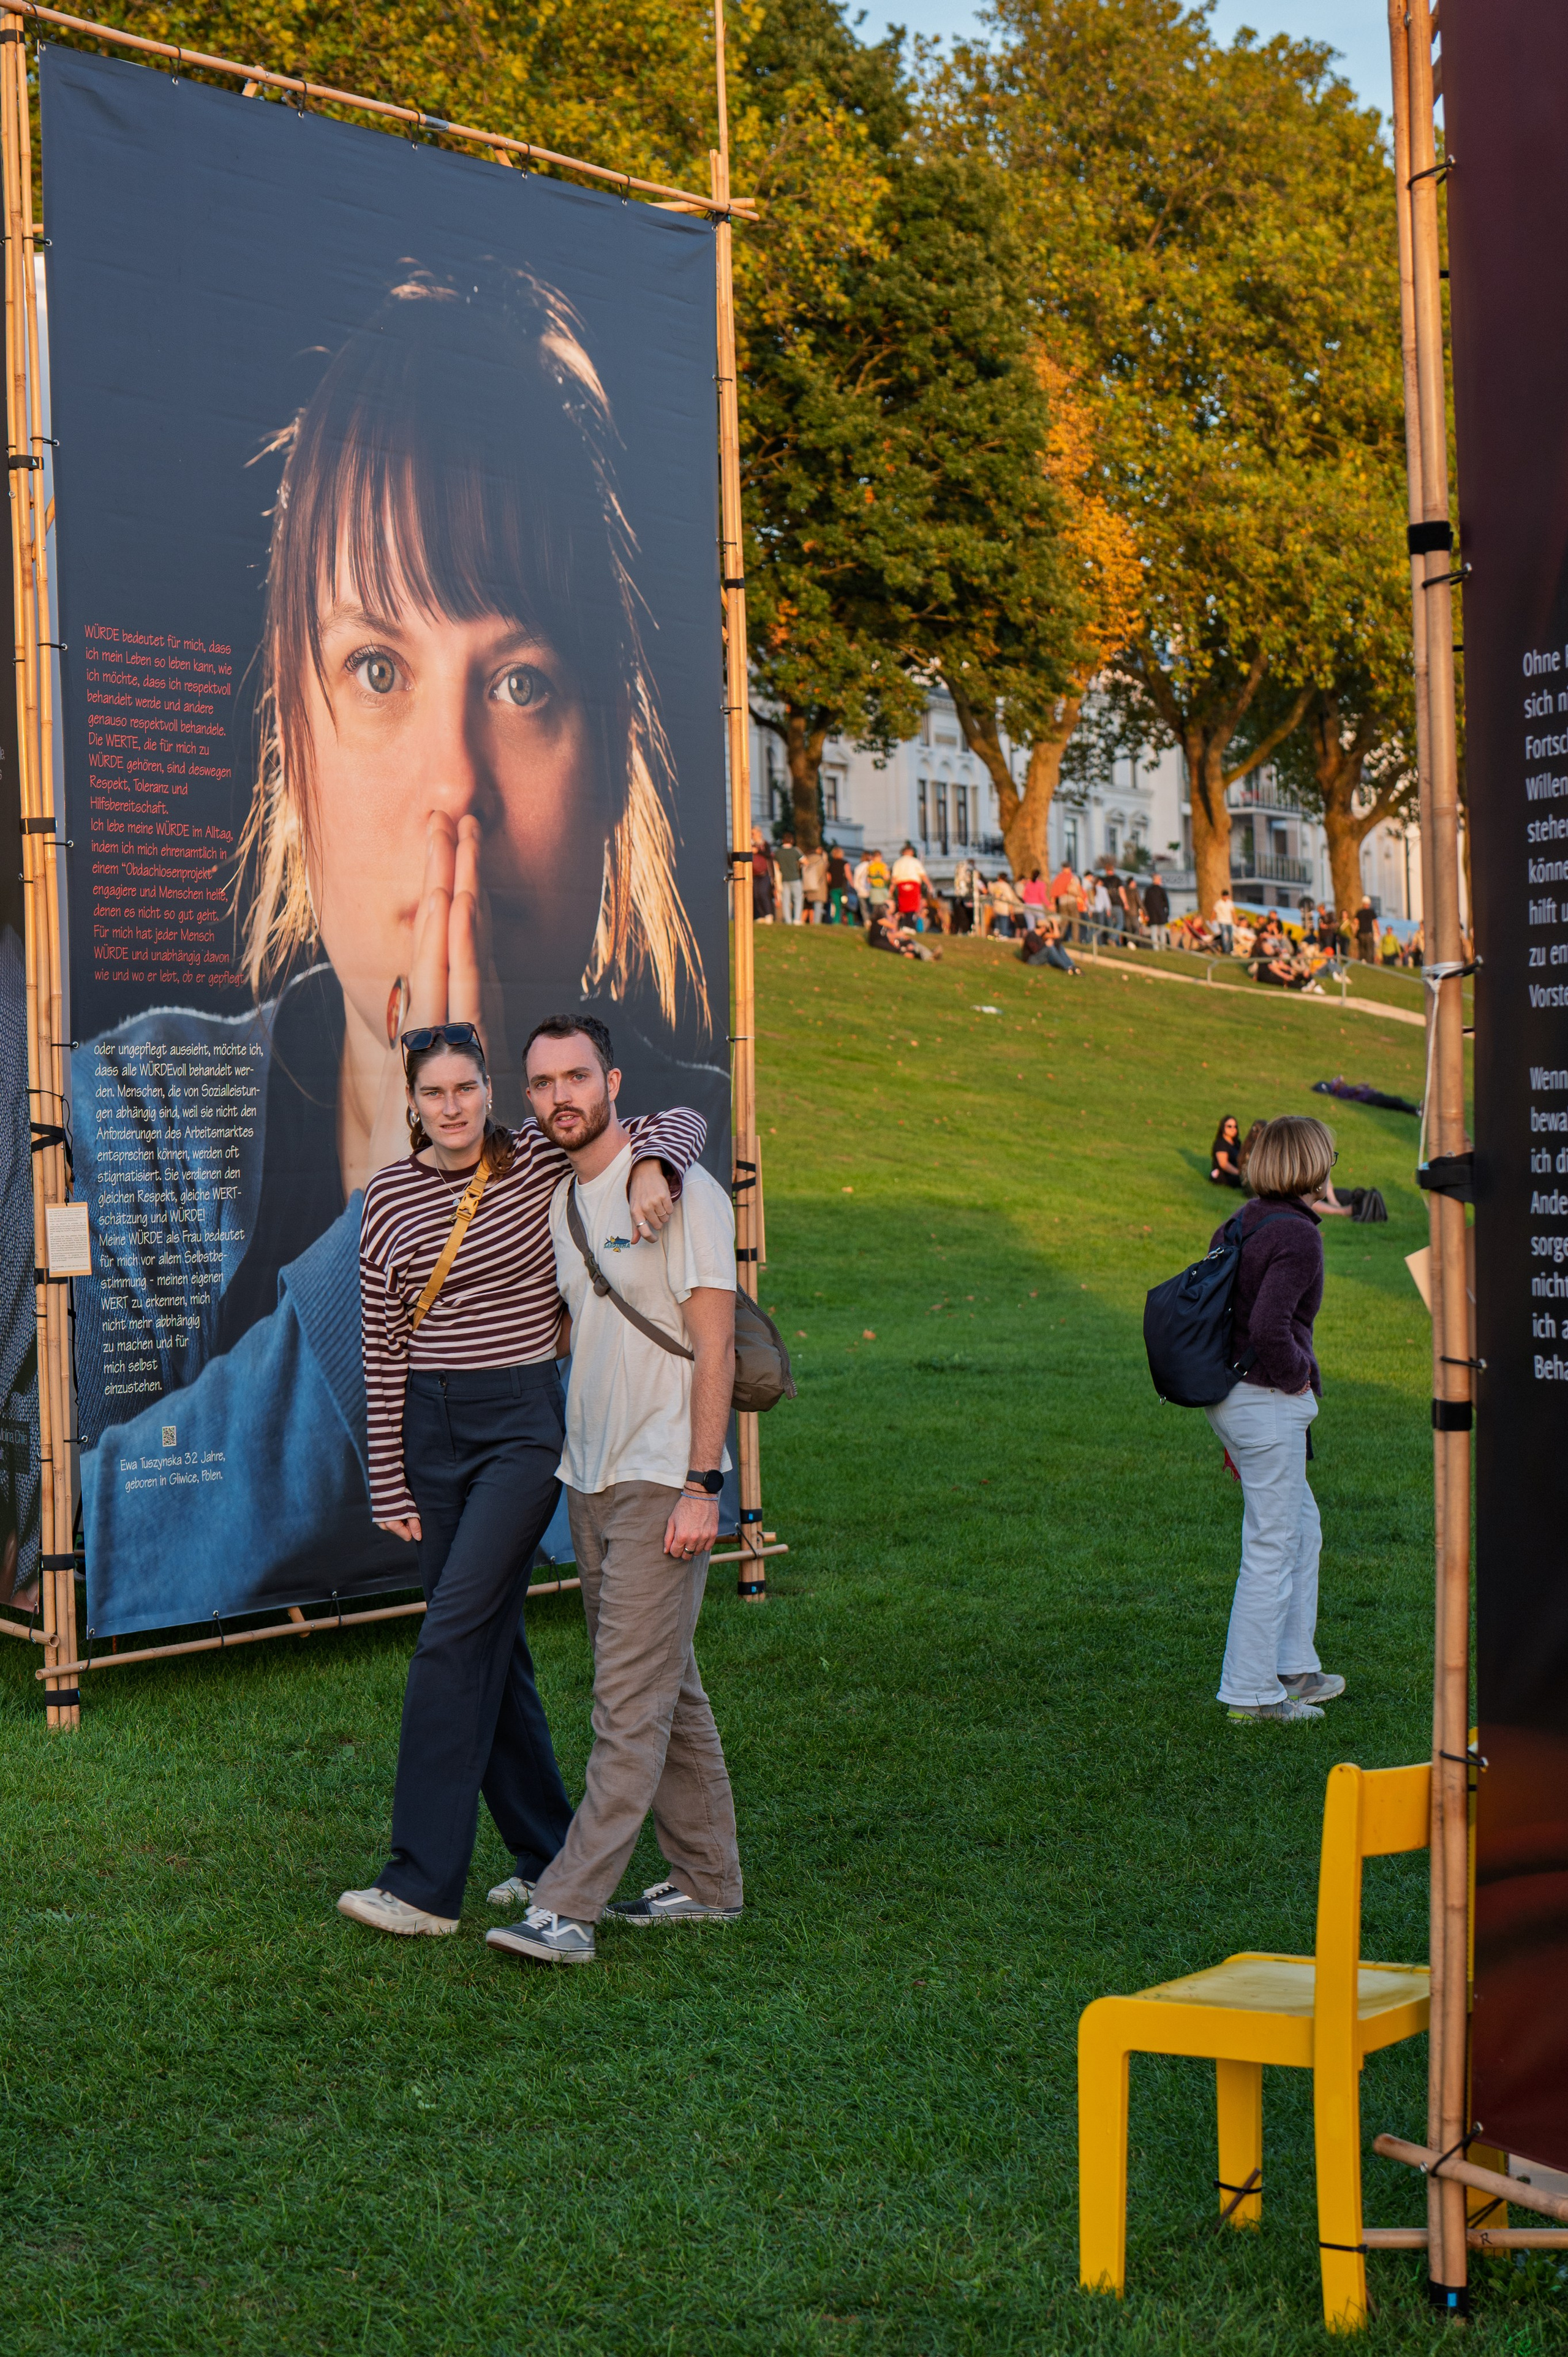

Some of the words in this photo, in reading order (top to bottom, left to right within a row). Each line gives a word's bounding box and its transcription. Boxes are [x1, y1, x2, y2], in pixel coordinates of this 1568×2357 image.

[85, 623, 119, 641] WÜRDE
[123, 629, 164, 647] bedeutet
[167, 635, 180, 648] für
[184, 638, 206, 653] mich,
[209, 641, 232, 654] dass
[1523, 649, 1561, 678] Ohne
[86, 668, 99, 681] ich
[103, 672, 140, 686] möchte,
[143, 675, 165, 689] dass
[169, 678, 181, 690] ich
[184, 681, 231, 697] respektvoll
[87, 689, 132, 706] behandelt
[135, 697, 160, 709] werde
[164, 699, 180, 711] und
[184, 701, 213, 714] andere
[1524, 688, 1553, 719] sich
[88, 714, 127, 727] genauso
[130, 717, 178, 733] respektvoll
[181, 719, 226, 736] behandele.
[89, 732, 103, 745] Die
[105, 734, 141, 751] WERTE,
[144, 738, 157, 751] die
[159, 739, 173, 752] für
[176, 741, 196, 754] mich
[200, 746, 209, 755] zu
[1525, 732, 1568, 760] Fortsc
[89, 752, 123, 768] WÜRDE
[127, 757, 164, 773] gehören,
[167, 761, 185, 773] sind
[189, 763, 232, 780] deswegen
[90, 775, 130, 793] Respekt,
[134, 779, 168, 794] Toleranz
[172, 783, 187, 795] und
[91, 796, 168, 814] Hilfsbereitschaft.
[91, 818, 104, 831] Ich
[107, 819, 124, 832] lebe
[128, 824, 153, 834] meine
[156, 821, 189, 836] WÜRDE
[192, 825, 202, 837] im
[205, 826, 233, 842] Alltag,
[91, 840, 118, 853] indem
[122, 842, 134, 854] ich
[138, 843, 157, 855] mich
[161, 844, 217, 858] ehrenamtlich
[220, 849, 227, 859] in
[92, 863, 118, 874] einem
[1529, 858, 1568, 885] könne
[93, 885, 137, 899] engagiere
[140, 883, 156, 897] und
[159, 886, 203, 901] Menschen
[206, 888, 228, 902] helfe,
[94, 904, 121, 917] denen
[124, 908, 135, 917] es
[138, 906, 161, 918] nicht
[164, 910, 175, 920] so
[178, 908, 194, 923] gut
[197, 909, 219, 923] geht.
[1529, 897, 1558, 926] hilft
[94, 925, 108, 937] Für
[113, 926, 133, 939] mich
[136, 927, 152, 939] hat
[154, 928, 177, 943] jeder
[181, 929, 214, 941] Mensch
[94, 944, 128, 960] WÜRDE
[132, 947, 148, 960] und
[151, 948, 200, 965] unabhängig
[203, 950, 229, 963] davon
[1529, 946, 1545, 967] zu
[1529, 983, 1568, 1008] Vorste
[94, 1042, 115, 1055] oder
[119, 1042, 167, 1059] ungepflegt
[170, 1043, 211, 1056] aussieht,
[214, 1043, 246, 1055] möchte
[249, 1043, 263, 1057] ich,
[94, 1064, 118, 1076] dass
[122, 1064, 137, 1076] alle
[140, 1061, 186, 1076] WÜRDEvoll
[189, 1064, 232, 1076] behandelt
[235, 1066, 254, 1076] wer-
[1530, 1066, 1568, 1091] Wenn
[96, 1084, 114, 1097] den.
[118, 1084, 165, 1099] Menschen,
[168, 1084, 181, 1097] die
[184, 1087, 198, 1097] von
[202, 1084, 260, 1097] Sozialleistun-
[1531, 1105, 1568, 1132] bewa
[96, 1127, 161, 1142] Anforderungen
[165, 1127, 181, 1139] des
[184, 1125, 254, 1138] Arbeitsmarktes
[97, 1148, 154, 1165] entsprechen
[157, 1147, 190, 1160] können,
[192, 1146, 222, 1159] werden
[225, 1146, 239, 1158] oft
[1531, 1147, 1551, 1173] ich
[98, 1170, 162, 1186] stigmatisiert.
[165, 1168, 179, 1180] Sie
[181, 1167, 221, 1180] verdienen
[224, 1167, 240, 1179] den
[98, 1191, 134, 1207] gleichen
[138, 1190, 177, 1206] Respekt,
[180, 1189, 209, 1206] gleiche
[212, 1186, 241, 1200] WERT-
[1531, 1189, 1568, 1216] Ande
[99, 1211, 147, 1227] schätzung
[151, 1209, 167, 1223] und
[170, 1207, 205, 1222] WÜRDE!
[99, 1234, 126, 1246] Meine
[129, 1230, 163, 1245] WÜRDE
[167, 1231, 179, 1244] als
[183, 1230, 202, 1243] Frau
[205, 1228, 245, 1242] bedeutet
[100, 1255, 113, 1268] für
[117, 1254, 138, 1266] mich
[141, 1255, 156, 1266] vor
[159, 1252, 181, 1265] allem
[184, 1250, 227, 1263] Selbstbe-
[100, 1276, 146, 1290] stimmung
[157, 1274, 188, 1286] meinen
[191, 1273, 224, 1287] eigenen
[101, 1296, 129, 1310] WERT
[132, 1298, 142, 1308] zu
[146, 1294, 187, 1307] erkennen,
[190, 1292, 210, 1305] mich
[102, 1318, 126, 1331] nicht
[129, 1316, 153, 1330] mehr
[156, 1314, 200, 1329] abbhängig
[1532, 1312, 1556, 1339] ich
[104, 1342, 114, 1353] zu
[118, 1337, 153, 1351] machen
[156, 1334, 173, 1349] und
[175, 1334, 189, 1347] für
[104, 1358, 125, 1373] mich
[129, 1358, 158, 1372] selbst
[105, 1379, 162, 1395] einzustehen.
[120, 1459, 137, 1470] Ewa
[140, 1455, 182, 1470] Tuszynska
[184, 1452, 197, 1464] 32
[201, 1450, 225, 1463] Jahre,
[125, 1477, 157, 1493] geboren
[160, 1474, 167, 1486] in
[169, 1472, 199, 1485] Gliwice,
[202, 1470, 222, 1481] Polen.
